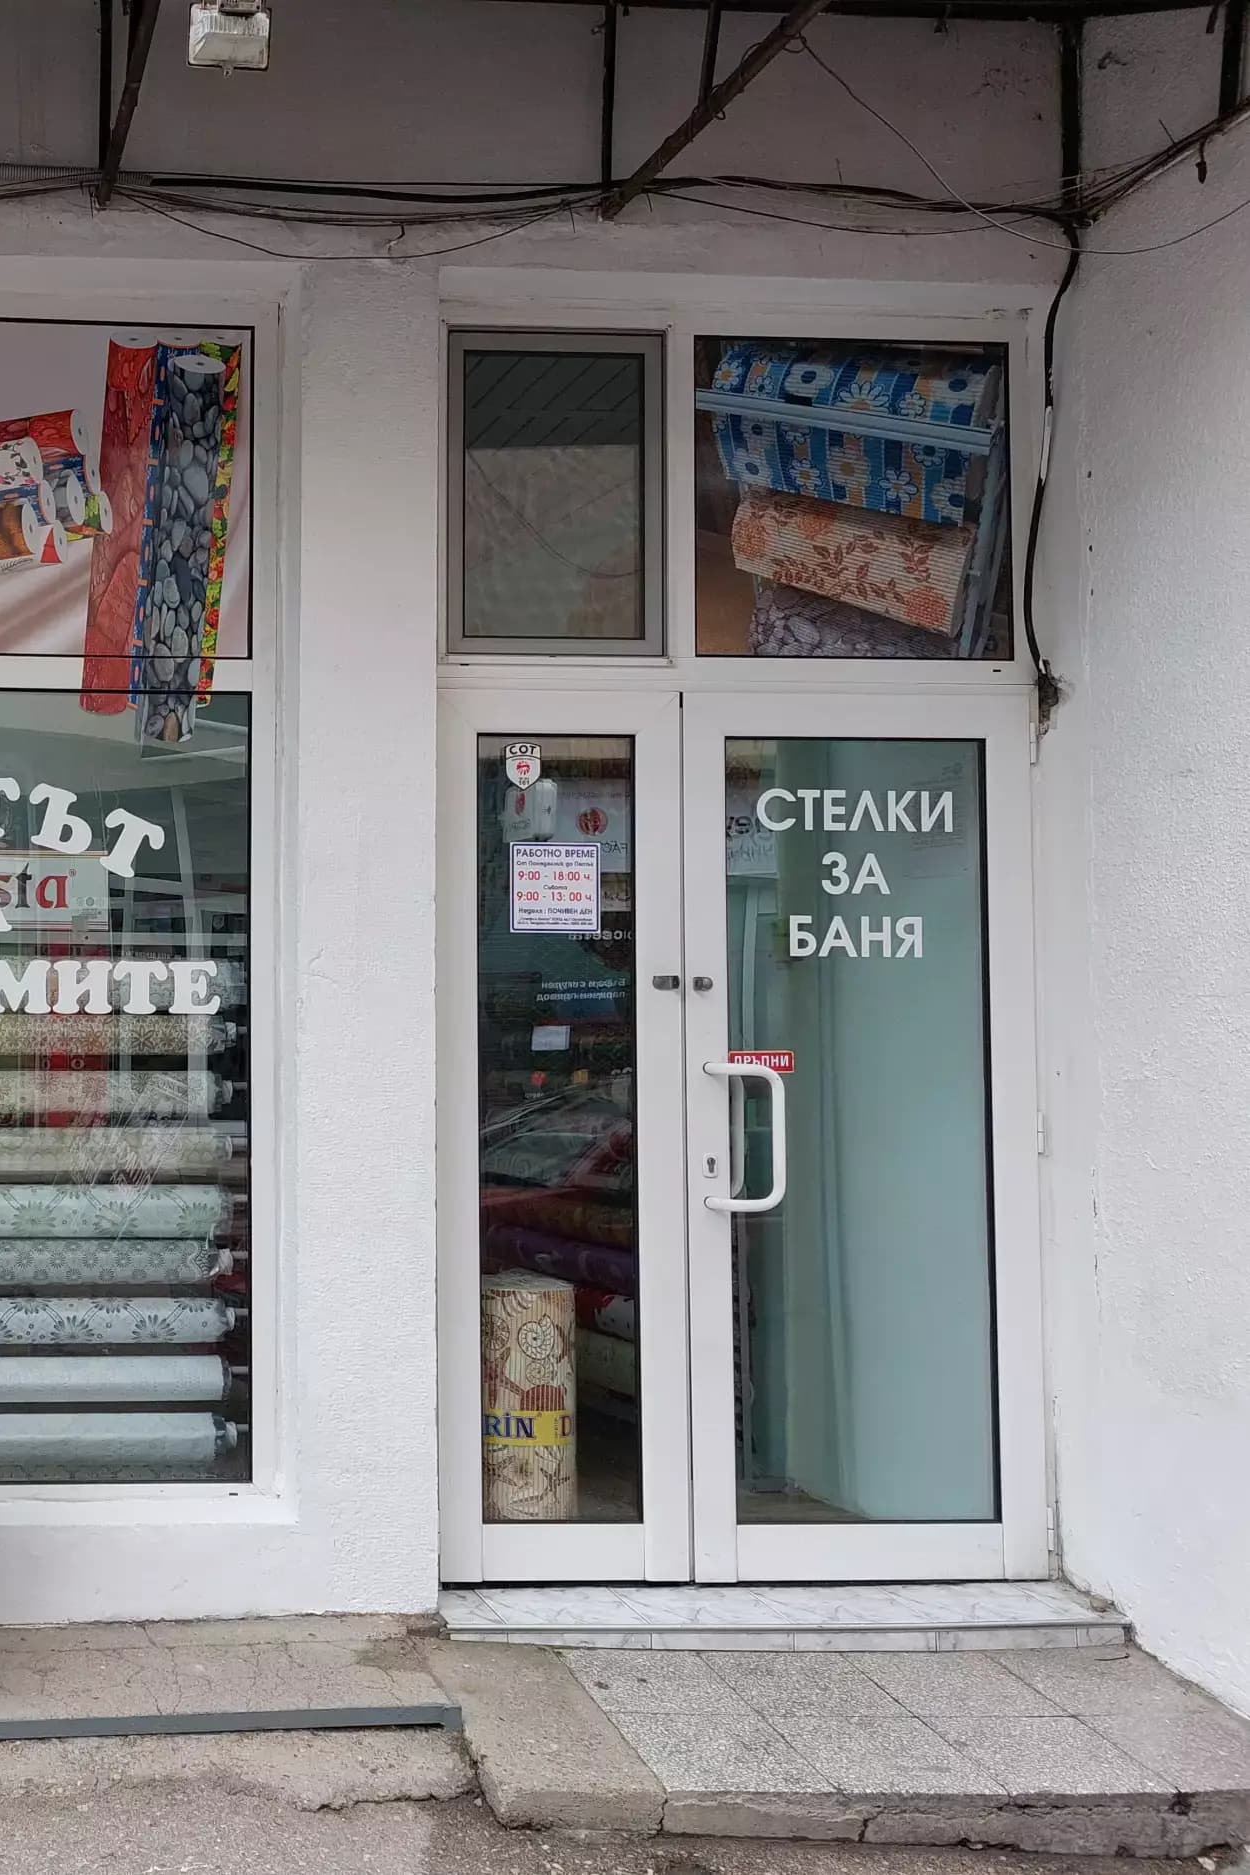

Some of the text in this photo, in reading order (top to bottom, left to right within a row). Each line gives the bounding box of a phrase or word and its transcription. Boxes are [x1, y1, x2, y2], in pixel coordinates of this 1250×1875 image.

[756, 788, 954, 833] СТЕЛКИ
[516, 848, 562, 858] РАБОТНО
[565, 849, 596, 858] ВРЕМЕ
[518, 870, 541, 881] 9:00
[553, 871, 581, 881] 18:00
[821, 851, 892, 896] ЗА
[516, 891, 540, 901] 9:00
[789, 915, 924, 959] БАНЯ
